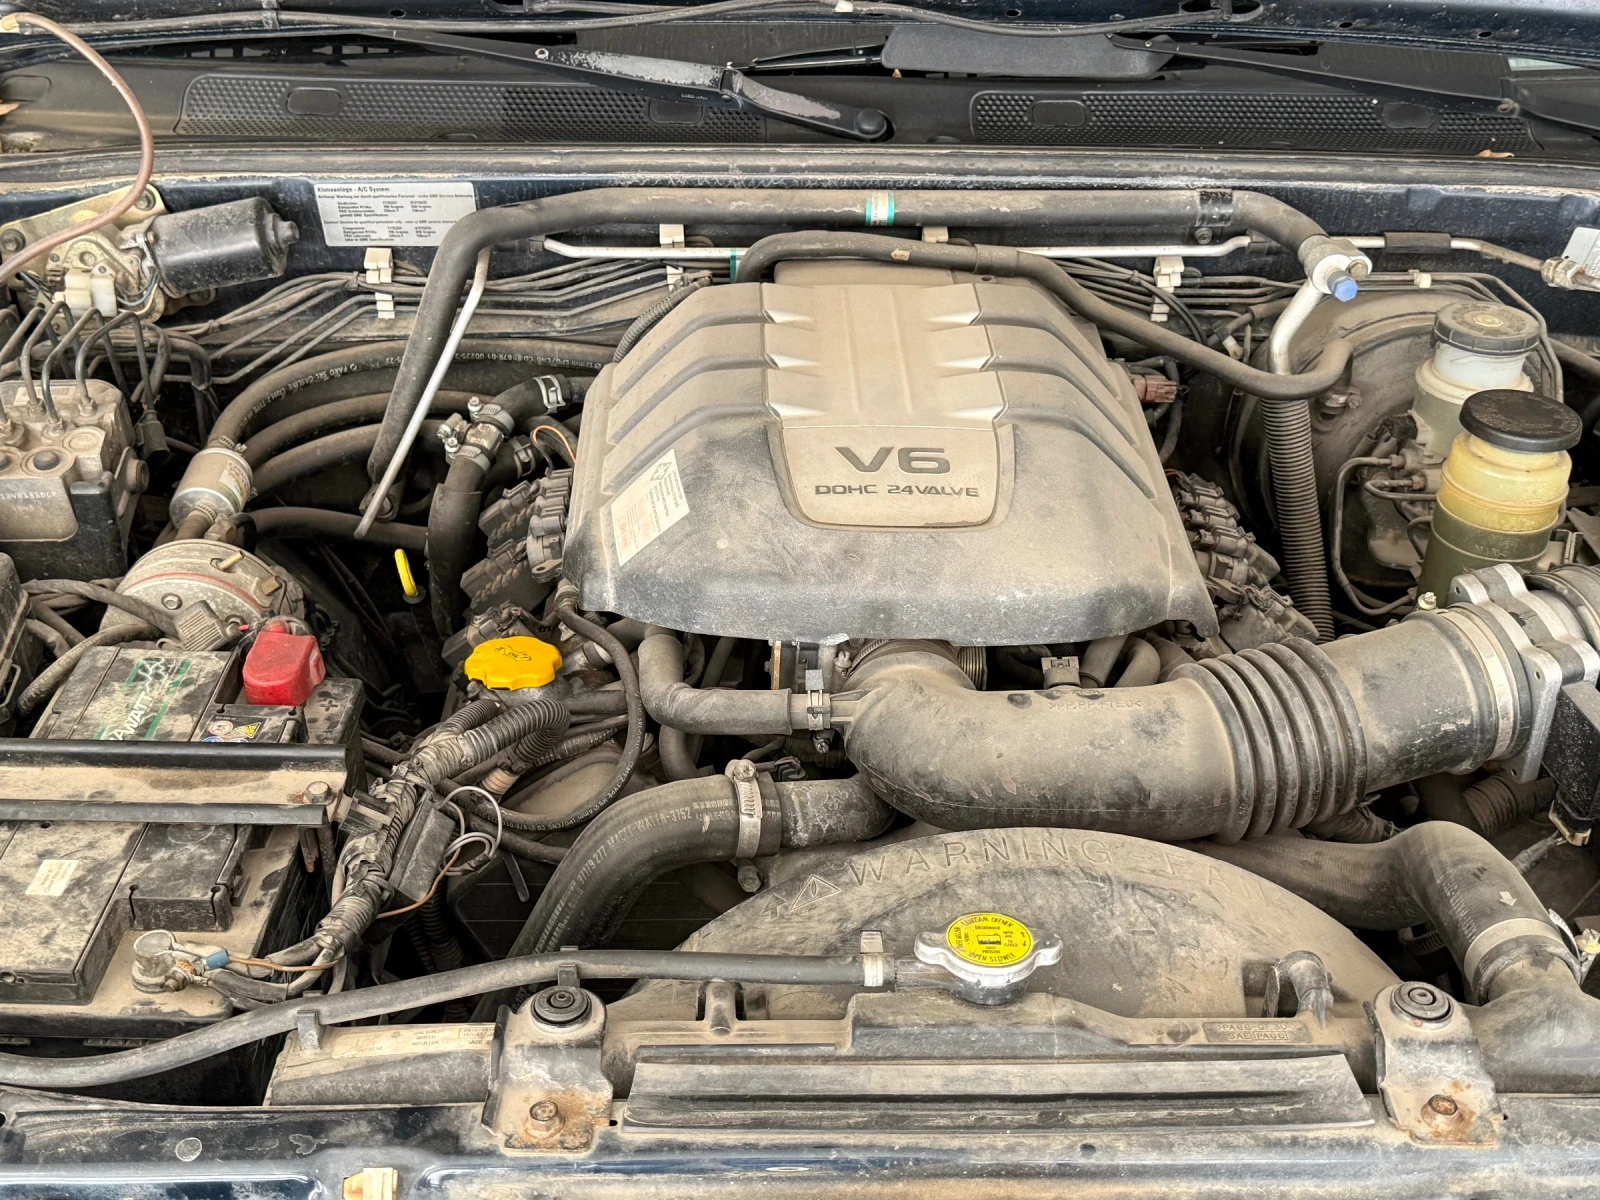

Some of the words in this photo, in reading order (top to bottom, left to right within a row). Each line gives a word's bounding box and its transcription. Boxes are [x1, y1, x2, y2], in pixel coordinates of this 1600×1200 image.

[834, 446, 950, 474] V6
[815, 484, 877, 495] DOHC
[108, 692, 154, 741] AWATT
[850, 836, 1112, 886] WARNING
[1164, 852, 1271, 907] FAN
[968, 951, 987, 961] OPEN
[990, 952, 1016, 962] SLOWLY
[1228, 1032, 1251, 1040] SAE
